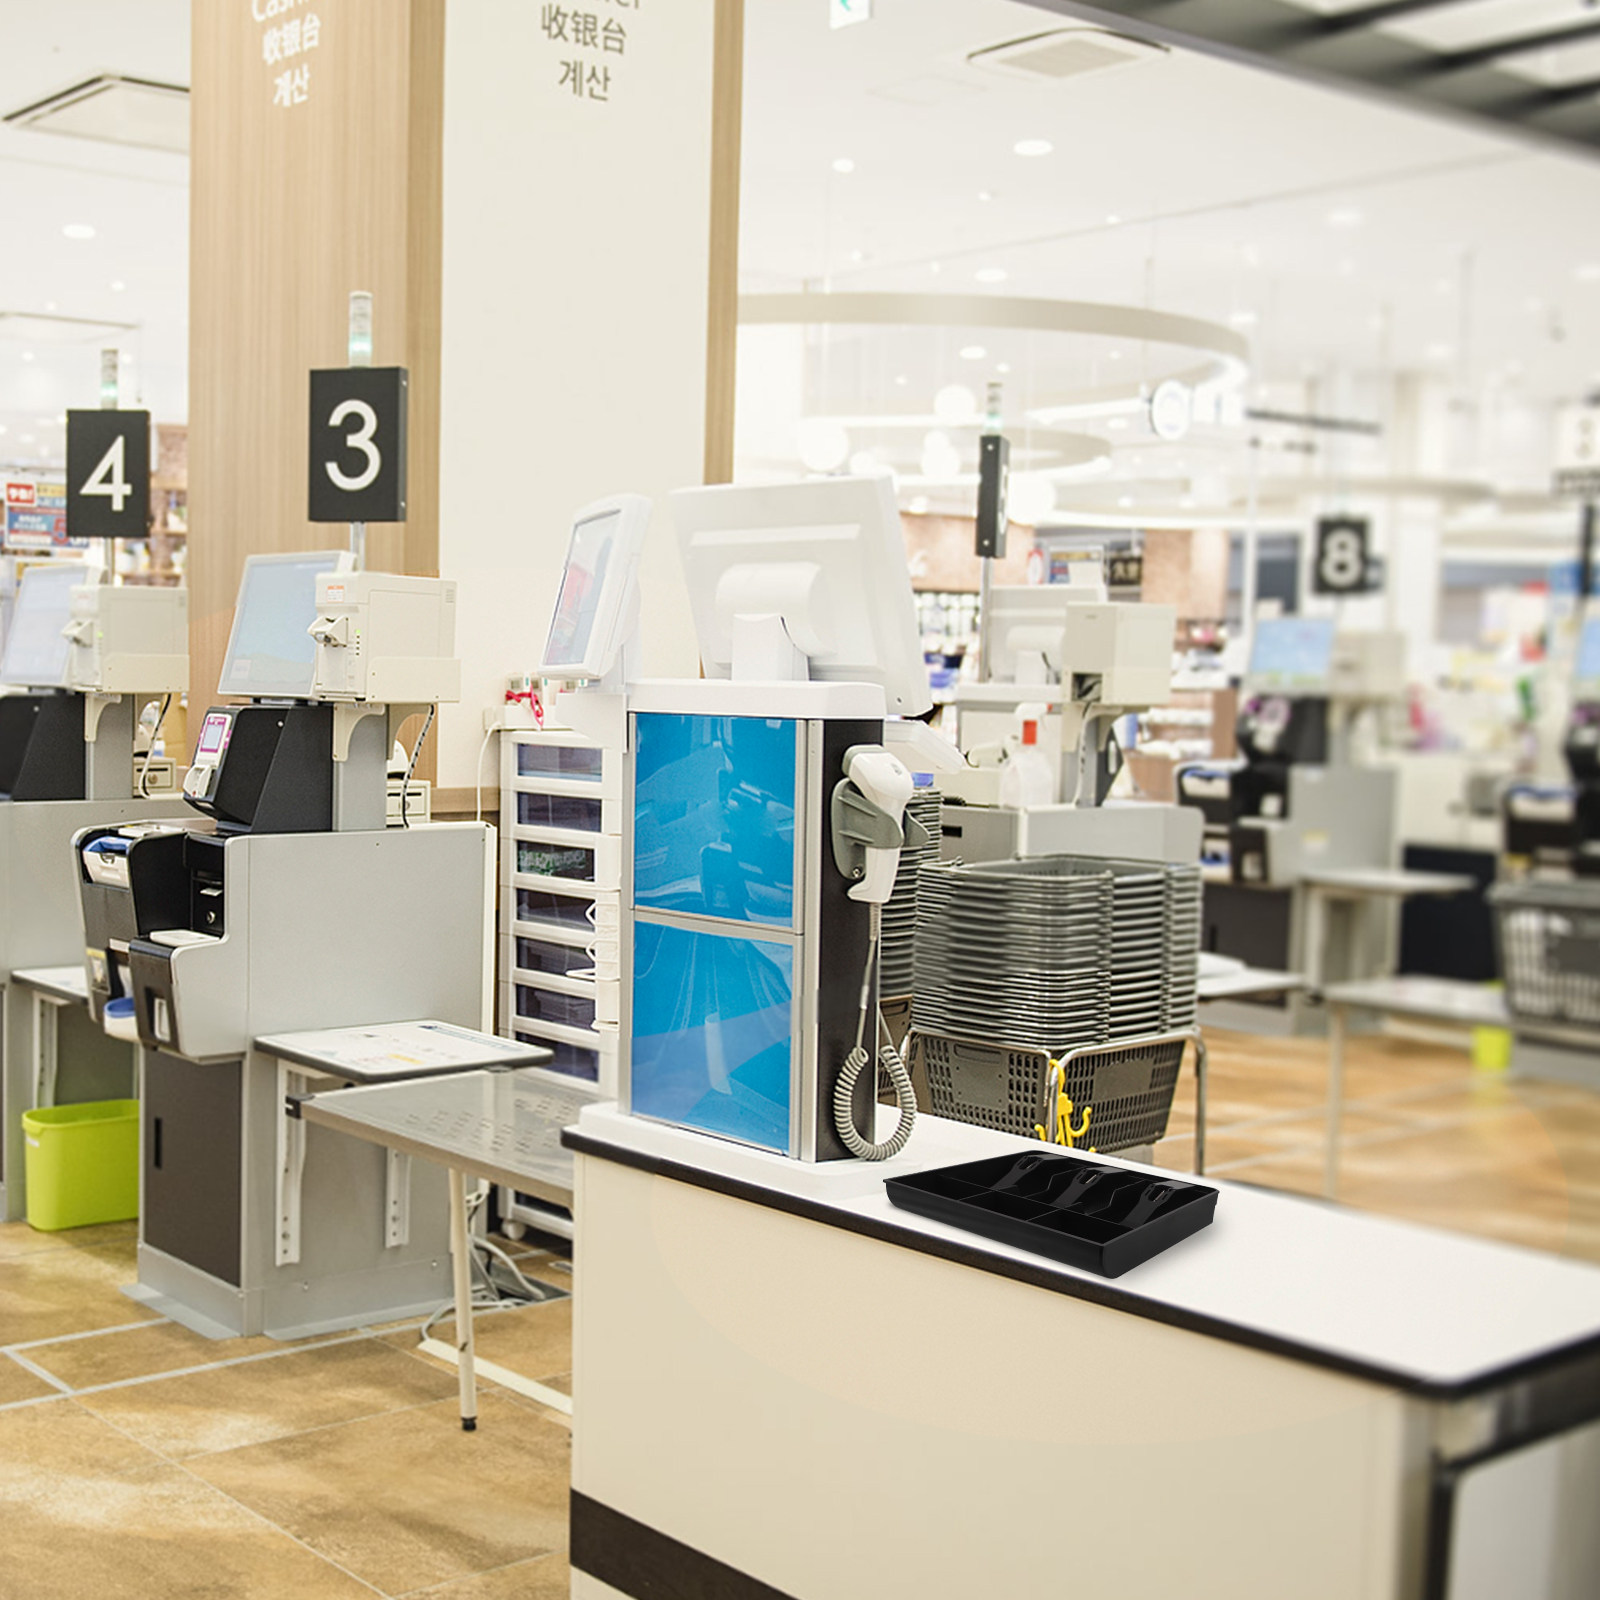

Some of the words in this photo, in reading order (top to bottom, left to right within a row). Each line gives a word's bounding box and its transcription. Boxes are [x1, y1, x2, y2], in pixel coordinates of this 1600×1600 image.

[263, 12, 321, 65] 收银台
[541, 3, 626, 55] 收银台
[273, 63, 309, 107] 계산
[559, 60, 611, 101] 계산
[325, 399, 381, 491] 3
[79, 435, 132, 511] 4
[1321, 528, 1362, 587] 8
